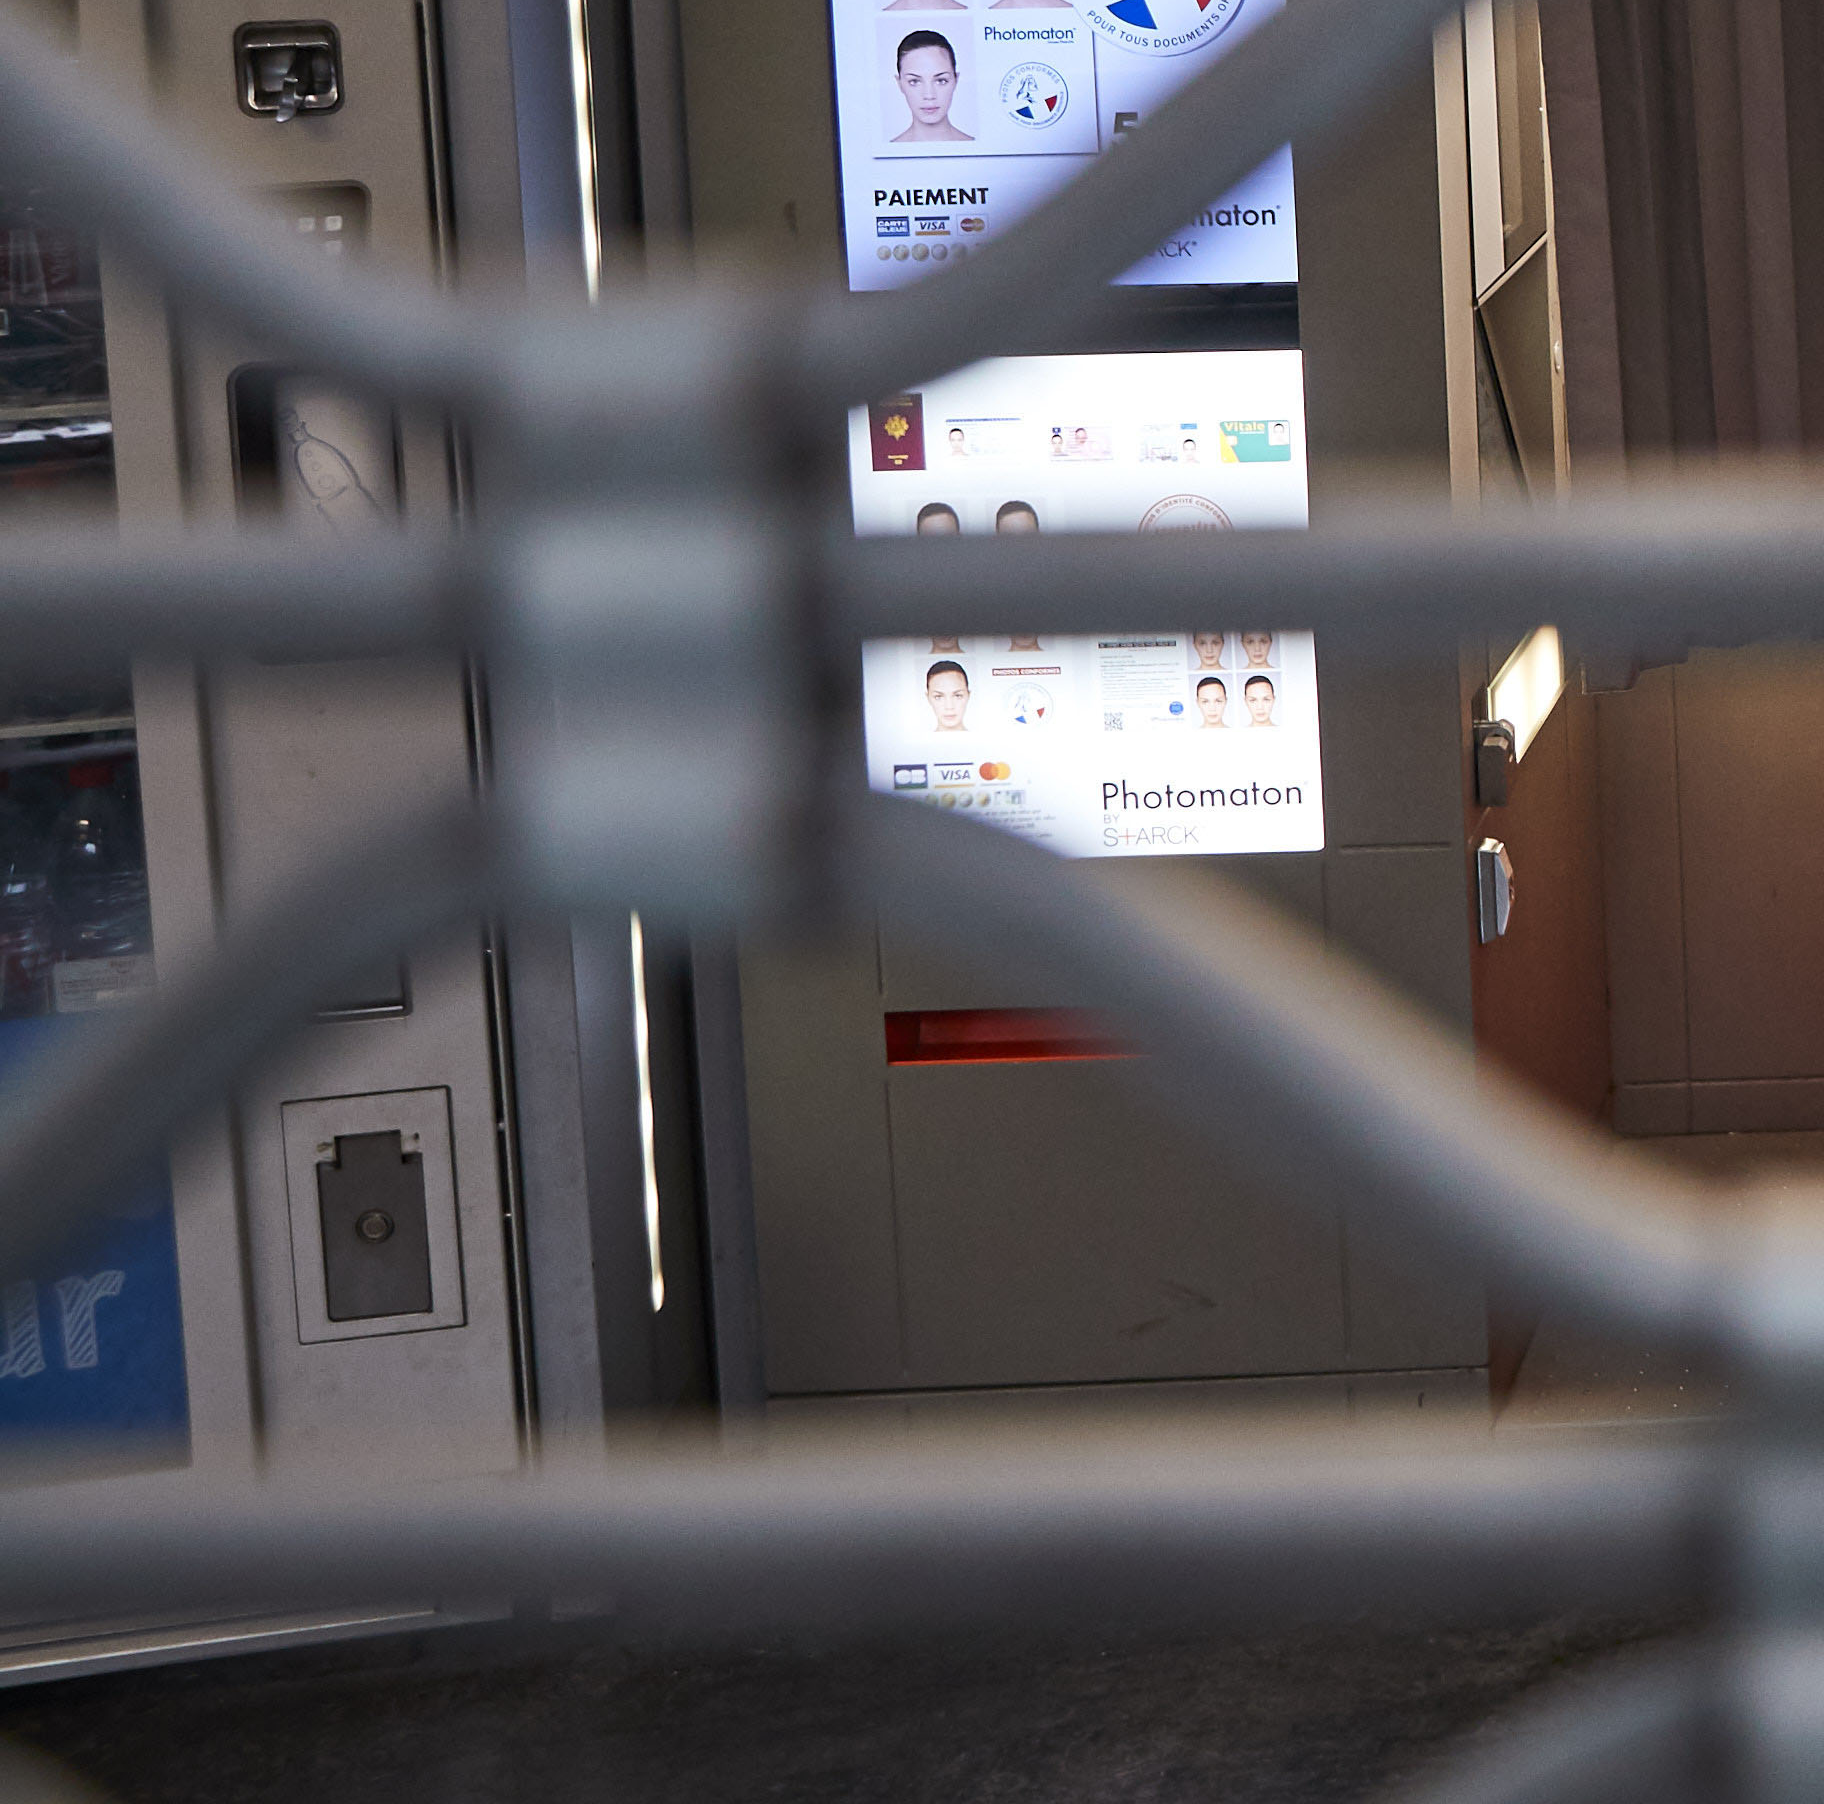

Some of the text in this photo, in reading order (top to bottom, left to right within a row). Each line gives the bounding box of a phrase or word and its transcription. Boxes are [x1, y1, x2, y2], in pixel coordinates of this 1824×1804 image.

[984, 26, 1074, 41] Photomaton
[1087, 10, 1117, 35] POUR
[1119, 30, 1149, 47] TOUS
[1154, 13, 1220, 48] DOCUMENTS
[874, 187, 989, 207] PAIEMENT
[920, 221, 946, 231] VISA
[1223, 421, 1266, 433] Vitale
[941, 769, 971, 781] VISA
[1102, 779, 1302, 810] Photomaton
[1103, 813, 1120, 824] BY
